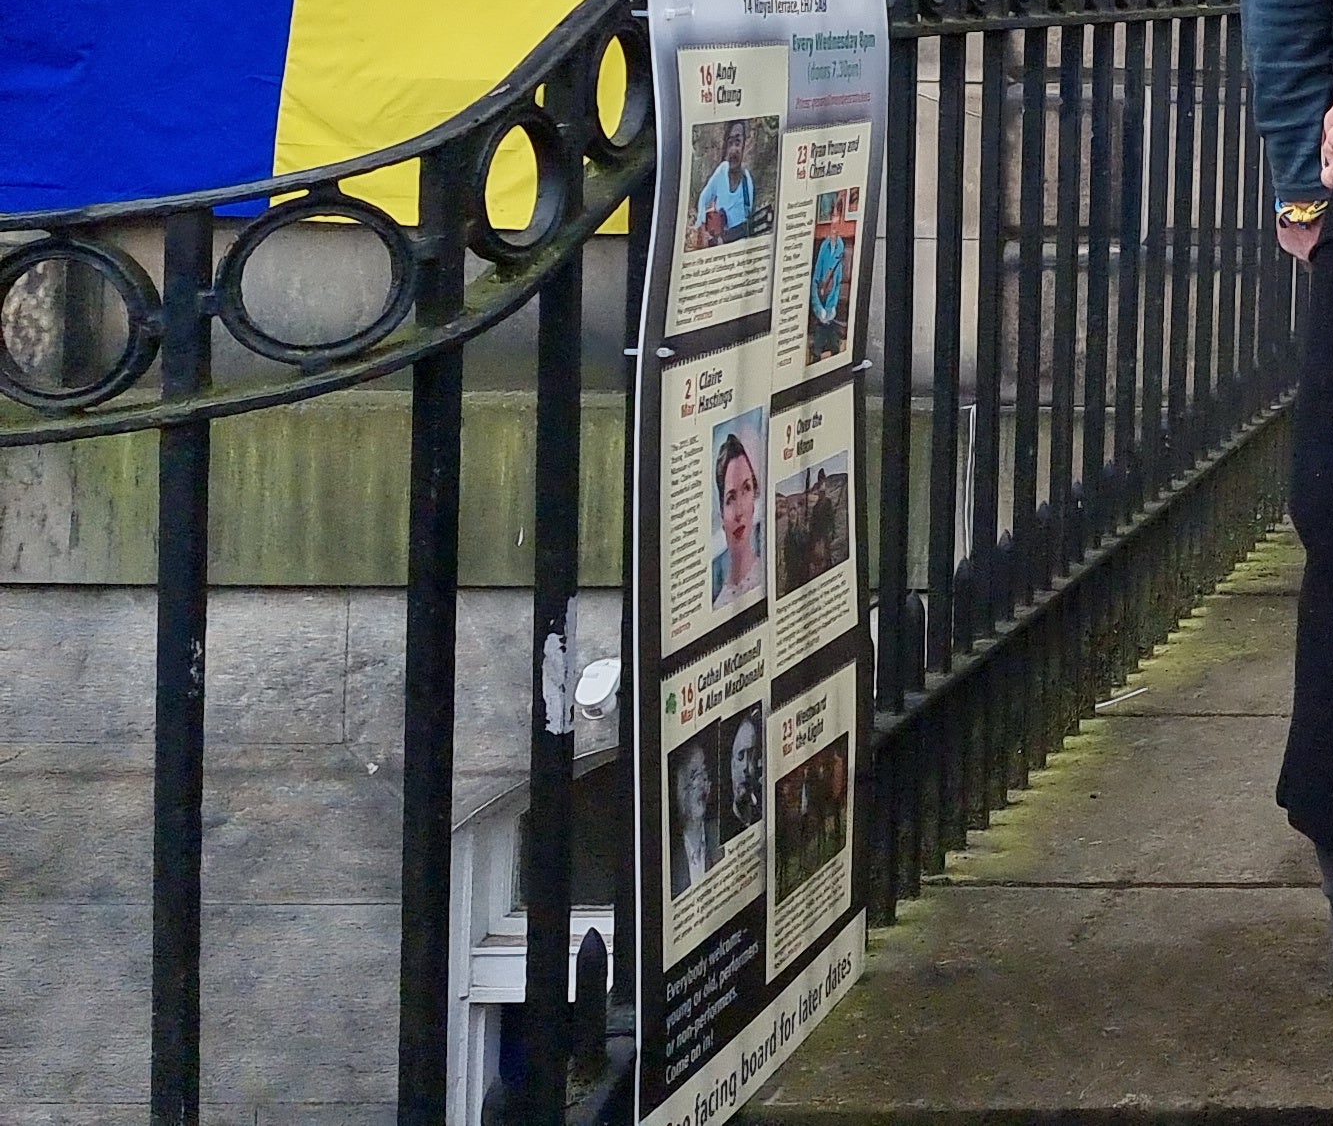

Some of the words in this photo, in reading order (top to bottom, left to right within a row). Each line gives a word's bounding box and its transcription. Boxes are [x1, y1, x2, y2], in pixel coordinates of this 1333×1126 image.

[792, 33, 814, 57] Every
[815, 30, 859, 53] Wednesday
[860, 33, 876, 53] 8pm
[699, 65, 712, 86] 16
[716, 61, 738, 82] Andy
[700, 90, 713, 104] Feb
[716, 85, 742, 106] Chung
[797, 145, 807, 165] 23
[797, 165, 806, 179] Feb
[685, 378, 692, 400] 2
[699, 367, 723, 390] Claire
[680, 403, 695, 418] Mar
[698, 387, 733, 414] Hastings
[786, 424, 792, 445] 9
[697, 661, 723, 692] Cathal
[724, 638, 762, 675] McConnell
[681, 682, 694, 706] 16
[697, 697, 704, 717] &
[705, 690, 722, 712] Alan
[724, 658, 765, 701] MacDonald
[681, 708, 695, 724] Mar
[783, 717, 793, 741] 23
[666, 957, 707, 1002] Everybody
[708, 930, 742, 965] welcome
[666, 997, 692, 1036] young
[694, 988, 702, 1006] or
[720, 941, 759, 989] performers
[666, 1040, 675, 1058] or
[694, 1070, 737, 1126] facing
[741, 1021, 777, 1086] board
[780, 1011, 796, 1047] for
[798, 982, 824, 1026] later
[825, 952, 852, 998] dates
[666, 1054, 689, 1085] Come
[690, 1043, 700, 1064] on
[702, 1028, 714, 1050] in!
